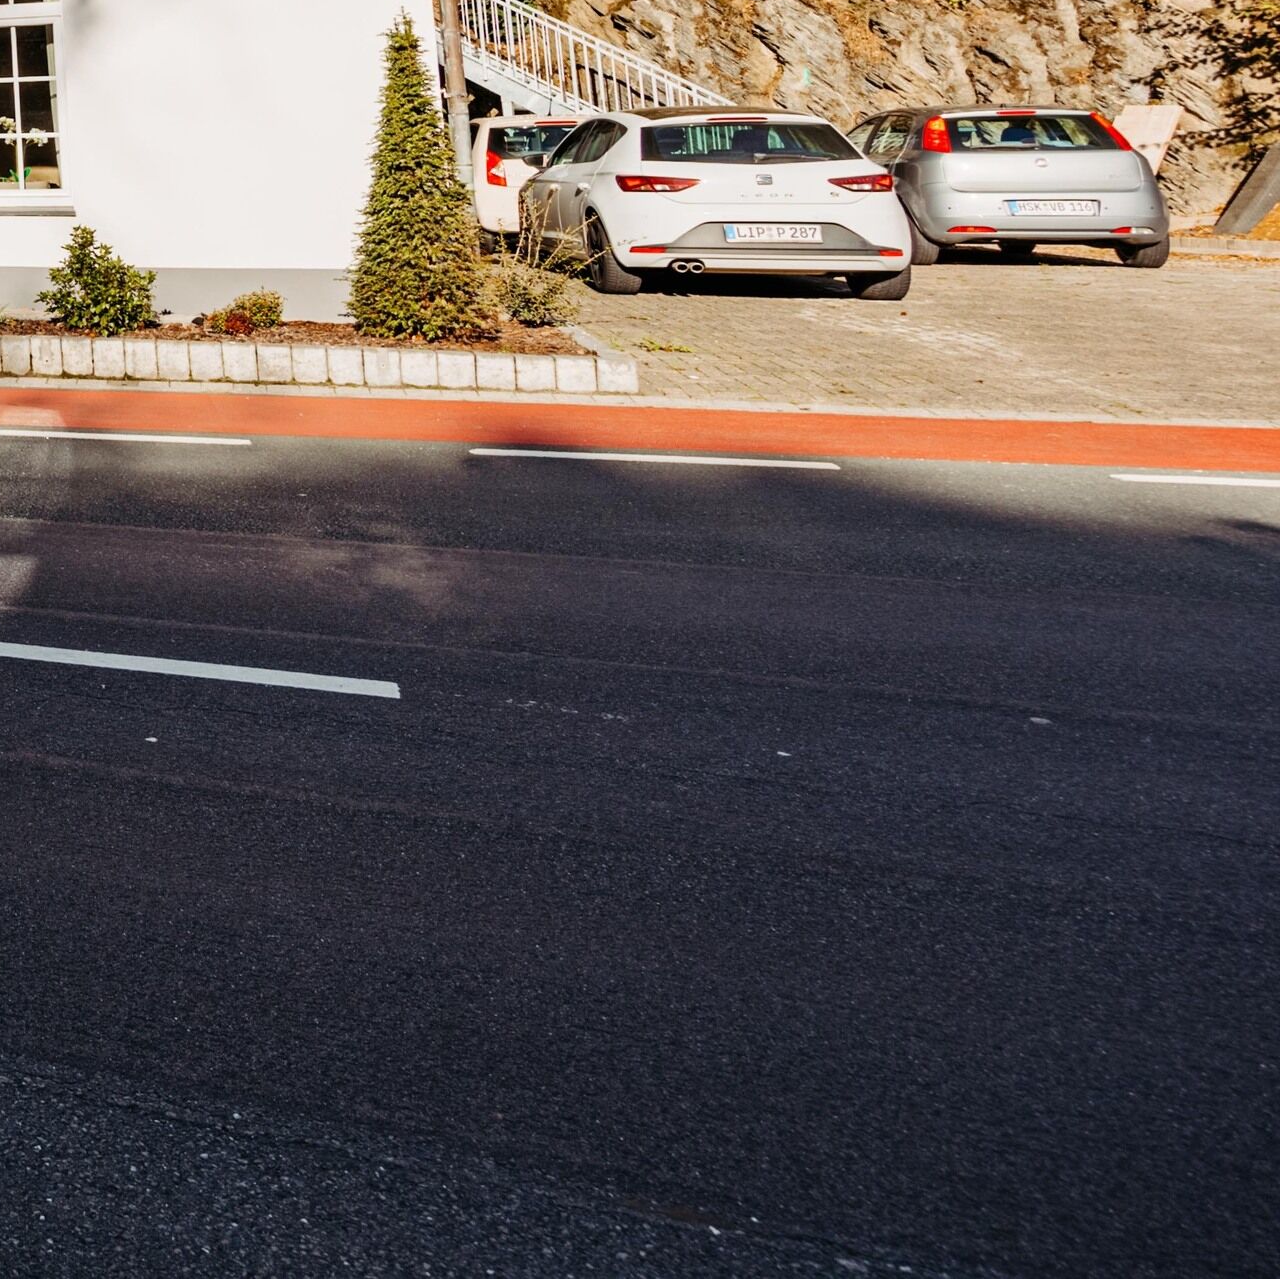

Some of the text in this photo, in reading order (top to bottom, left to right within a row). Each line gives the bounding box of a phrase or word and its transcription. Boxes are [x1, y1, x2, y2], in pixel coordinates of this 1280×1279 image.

[1018, 202, 1042, 212] HSK
[736, 227, 817, 239] LIP P 287
